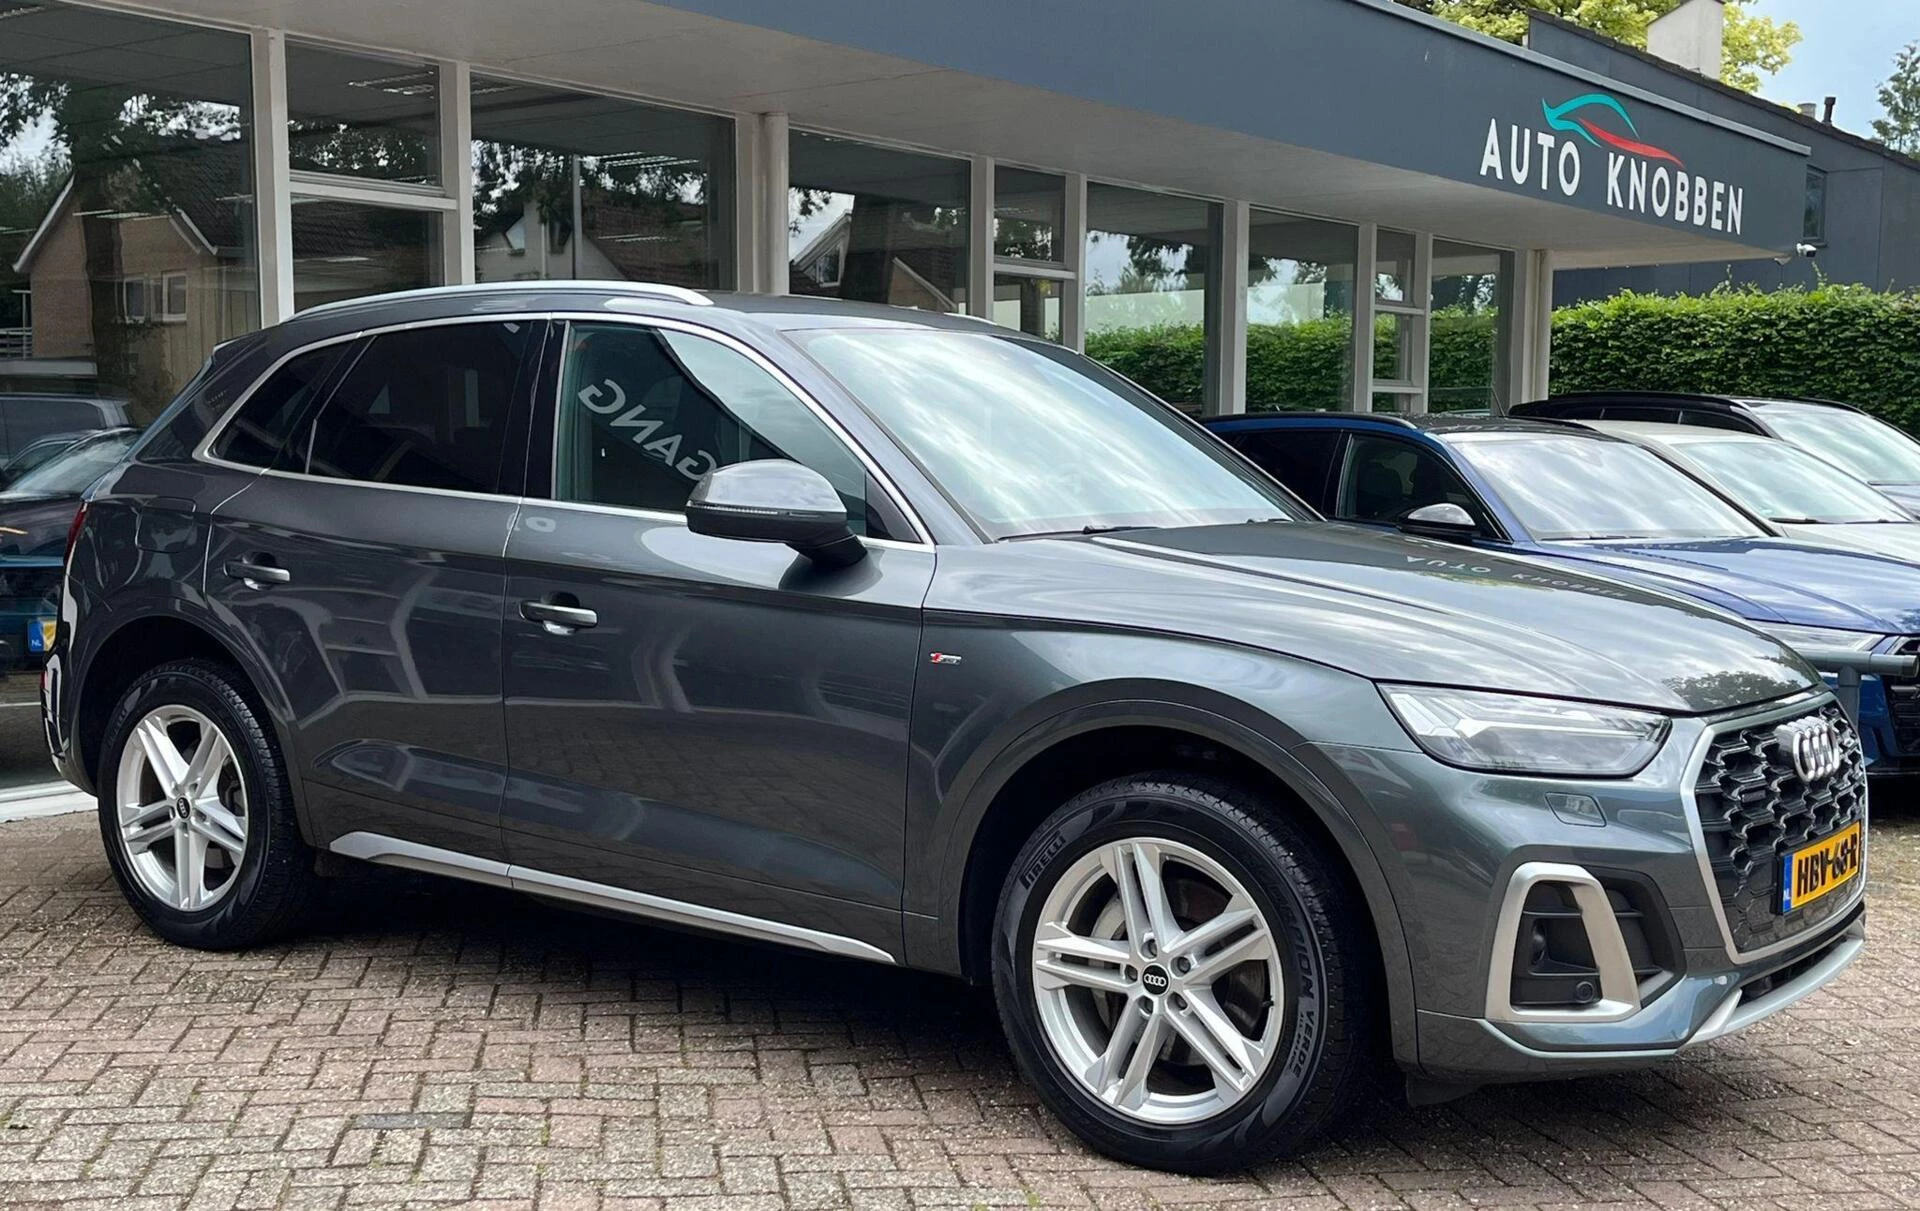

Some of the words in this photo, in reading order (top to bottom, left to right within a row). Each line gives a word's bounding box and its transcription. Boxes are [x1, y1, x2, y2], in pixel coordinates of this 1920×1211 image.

[1479, 117, 1581, 197] AUTO
[1606, 151, 1744, 236] KNOBBEN
[1018, 829, 1067, 891] PIRELLI
